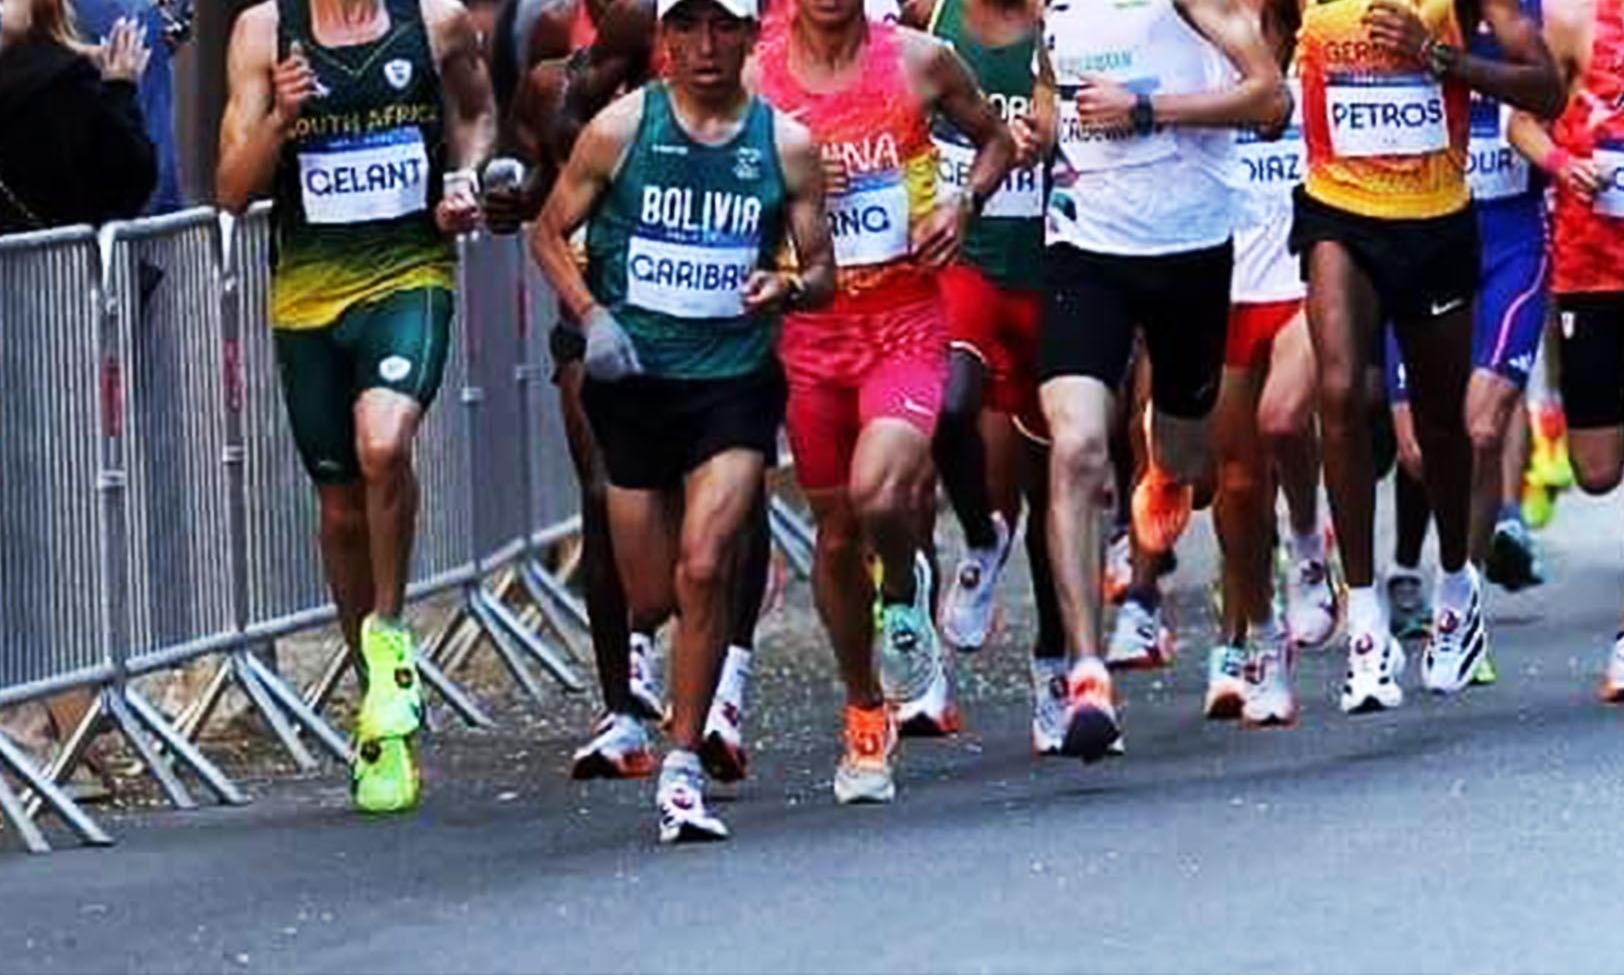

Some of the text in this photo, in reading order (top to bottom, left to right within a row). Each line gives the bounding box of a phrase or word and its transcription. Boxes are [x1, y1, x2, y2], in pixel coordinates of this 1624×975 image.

[1332, 98, 1442, 129] PETROS
[305, 157, 421, 196] GELANT
[641, 184, 763, 235] BOLIVIA
